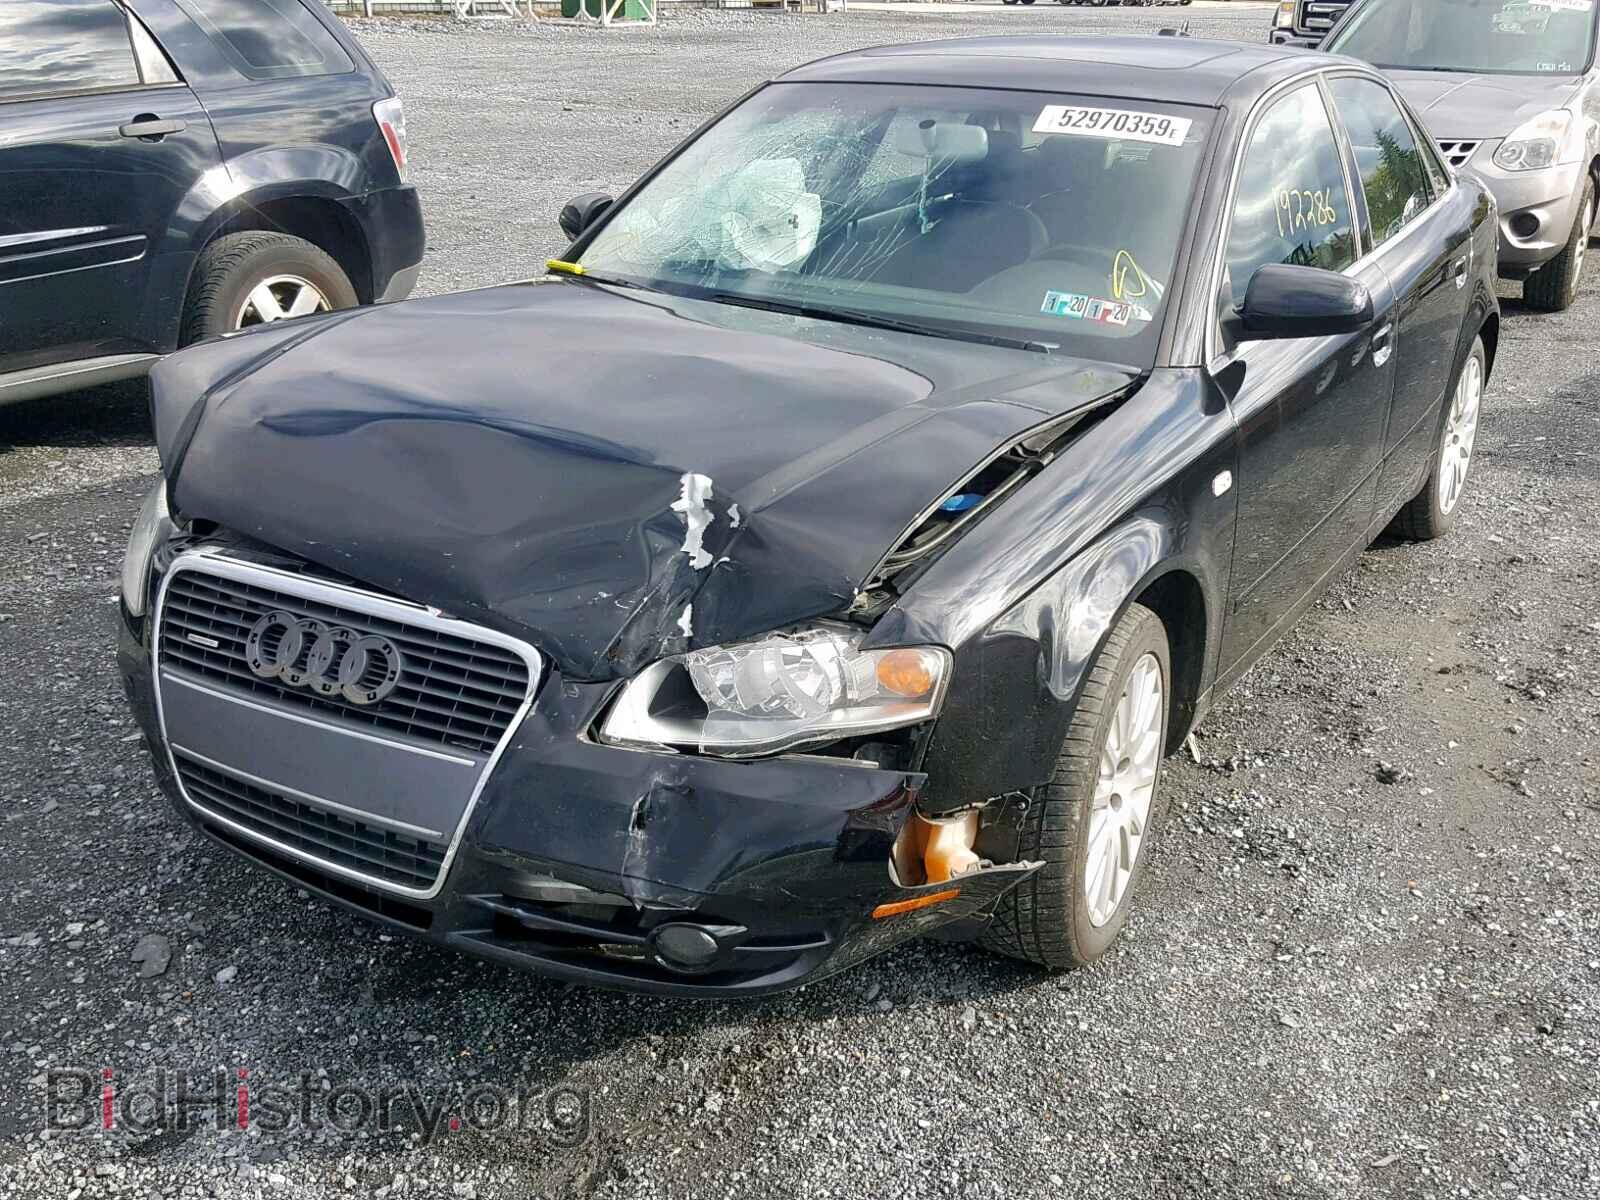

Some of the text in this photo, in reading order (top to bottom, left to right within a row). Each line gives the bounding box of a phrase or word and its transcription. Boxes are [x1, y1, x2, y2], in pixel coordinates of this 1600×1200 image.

[1271, 186, 1336, 238] 192286
[1070, 296, 1086, 313] 20
[1113, 306, 1129, 321] 20
